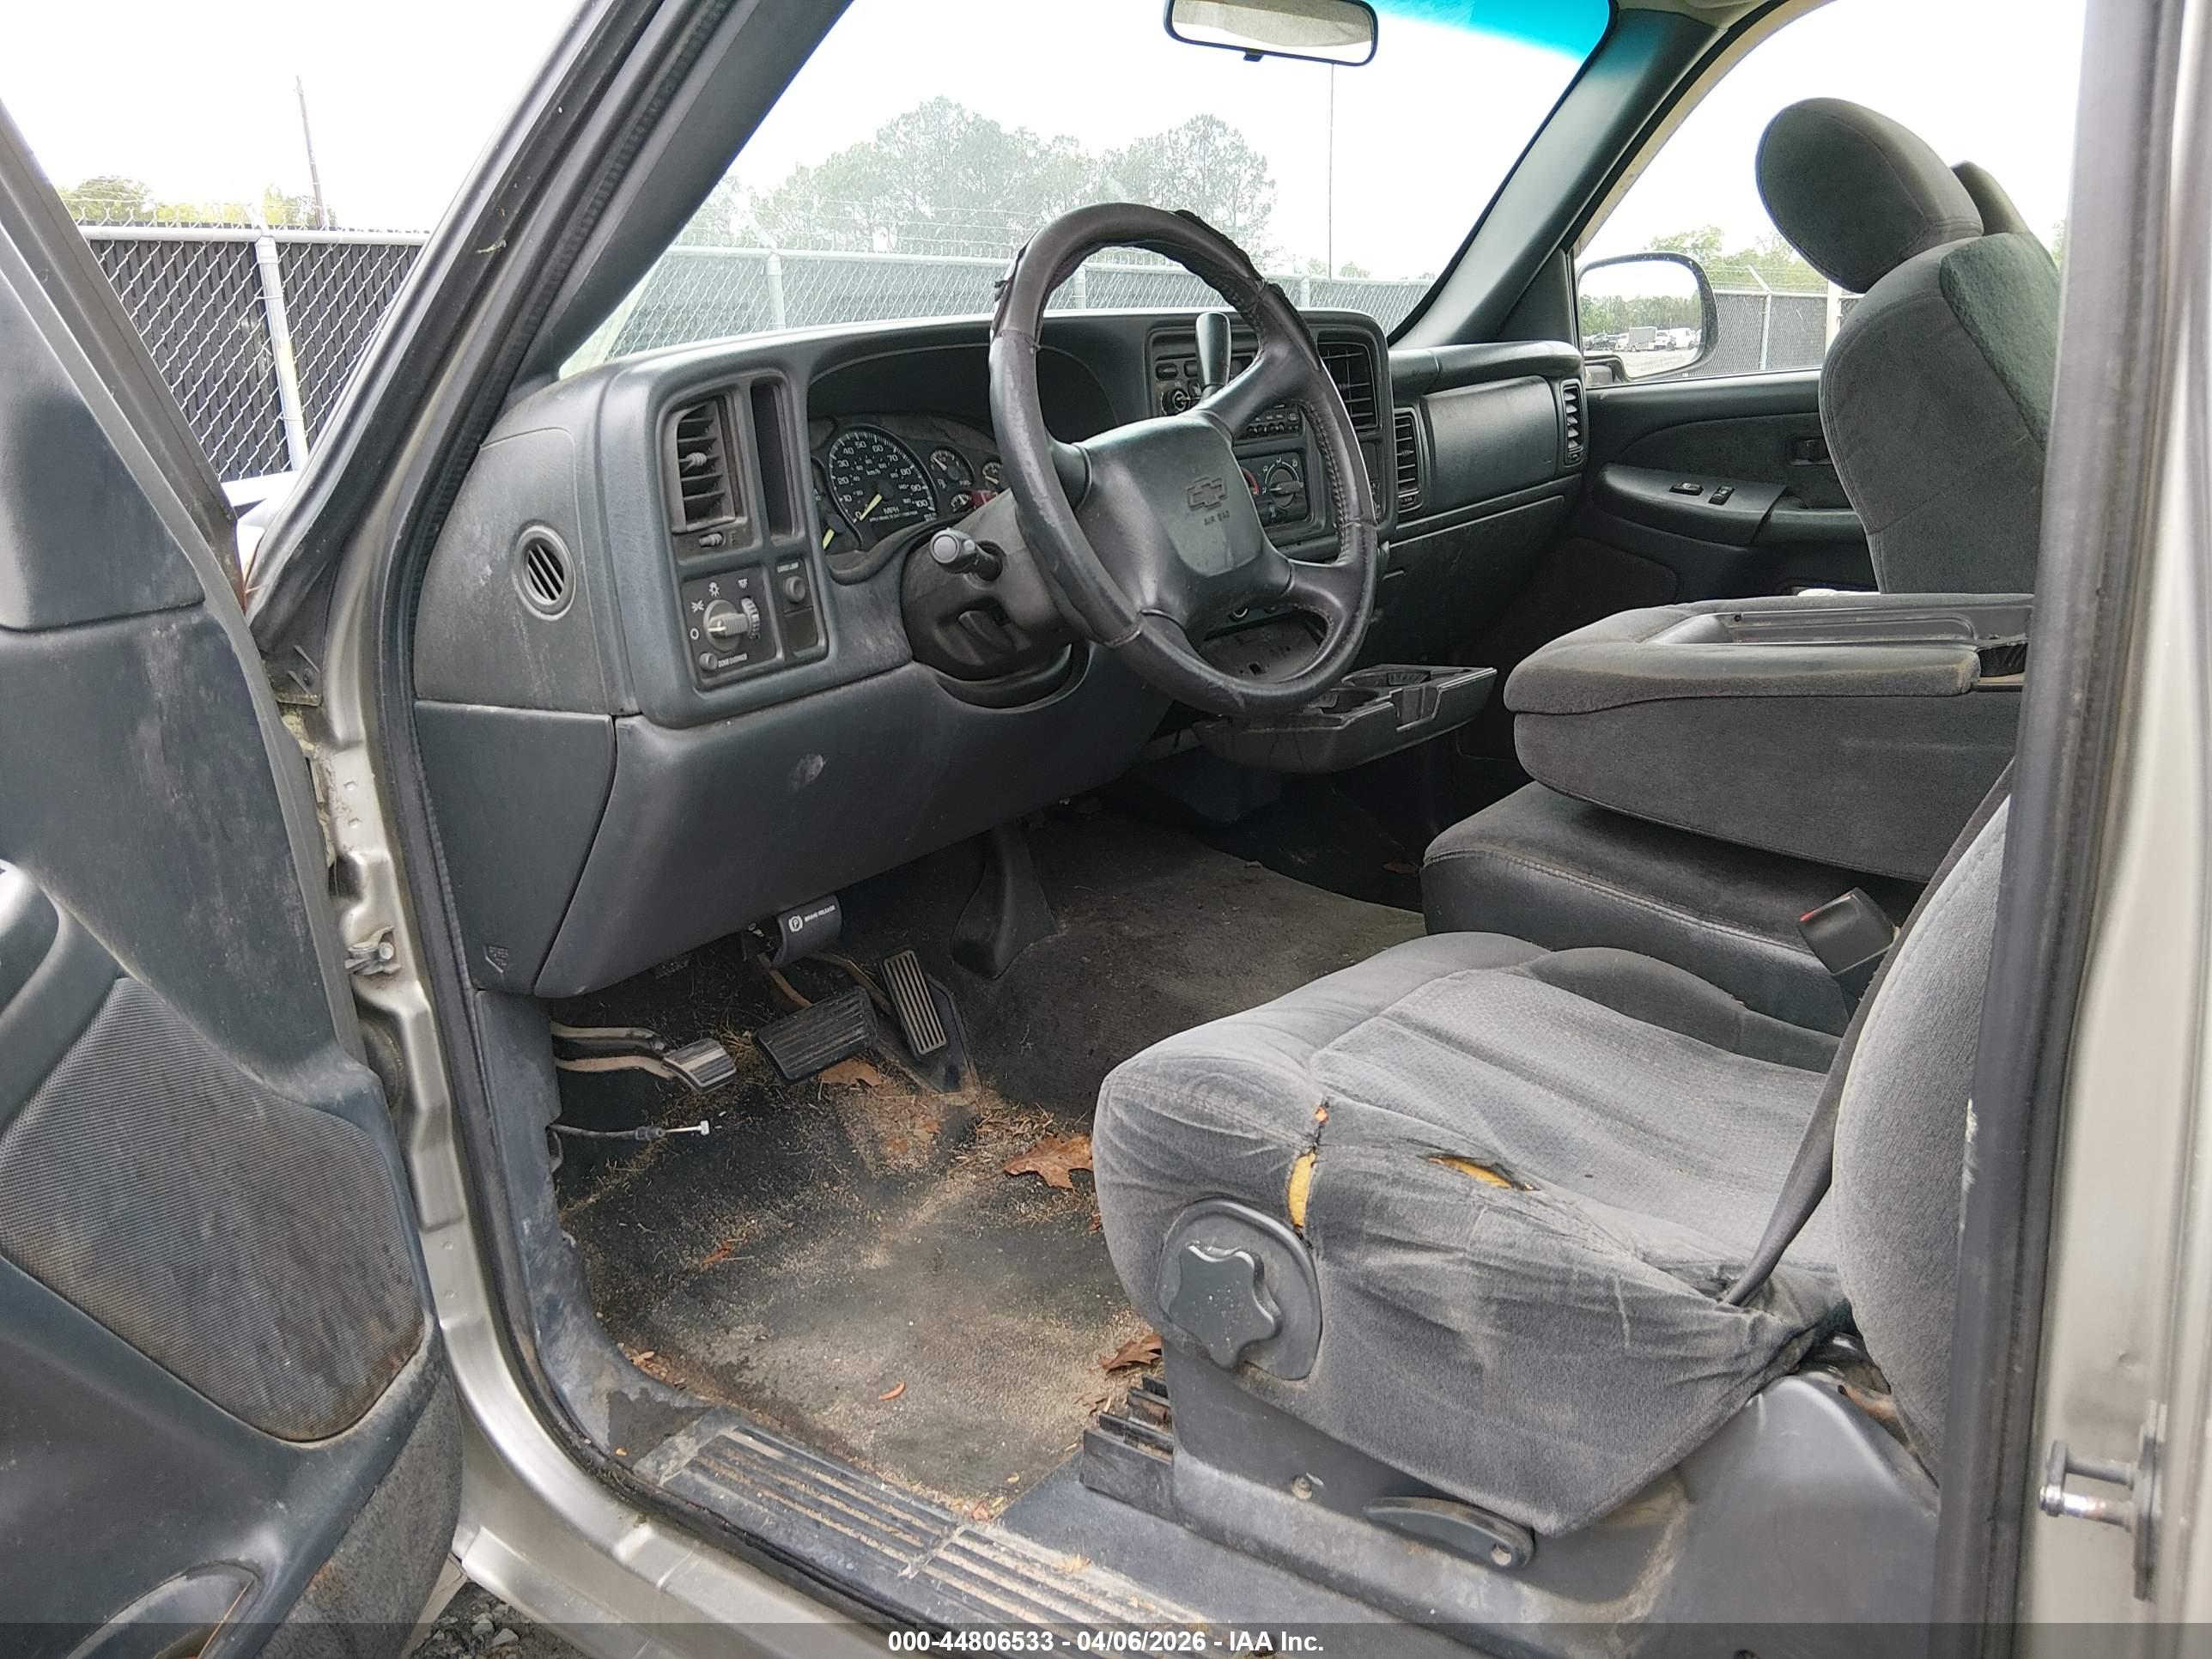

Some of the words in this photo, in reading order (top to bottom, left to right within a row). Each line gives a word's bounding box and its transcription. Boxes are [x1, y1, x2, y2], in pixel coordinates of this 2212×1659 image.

[854, 441, 866, 449] 50
[837, 476, 849, 485] 20
[842, 494, 853, 502] 10
[915, 499, 928, 507] 100
